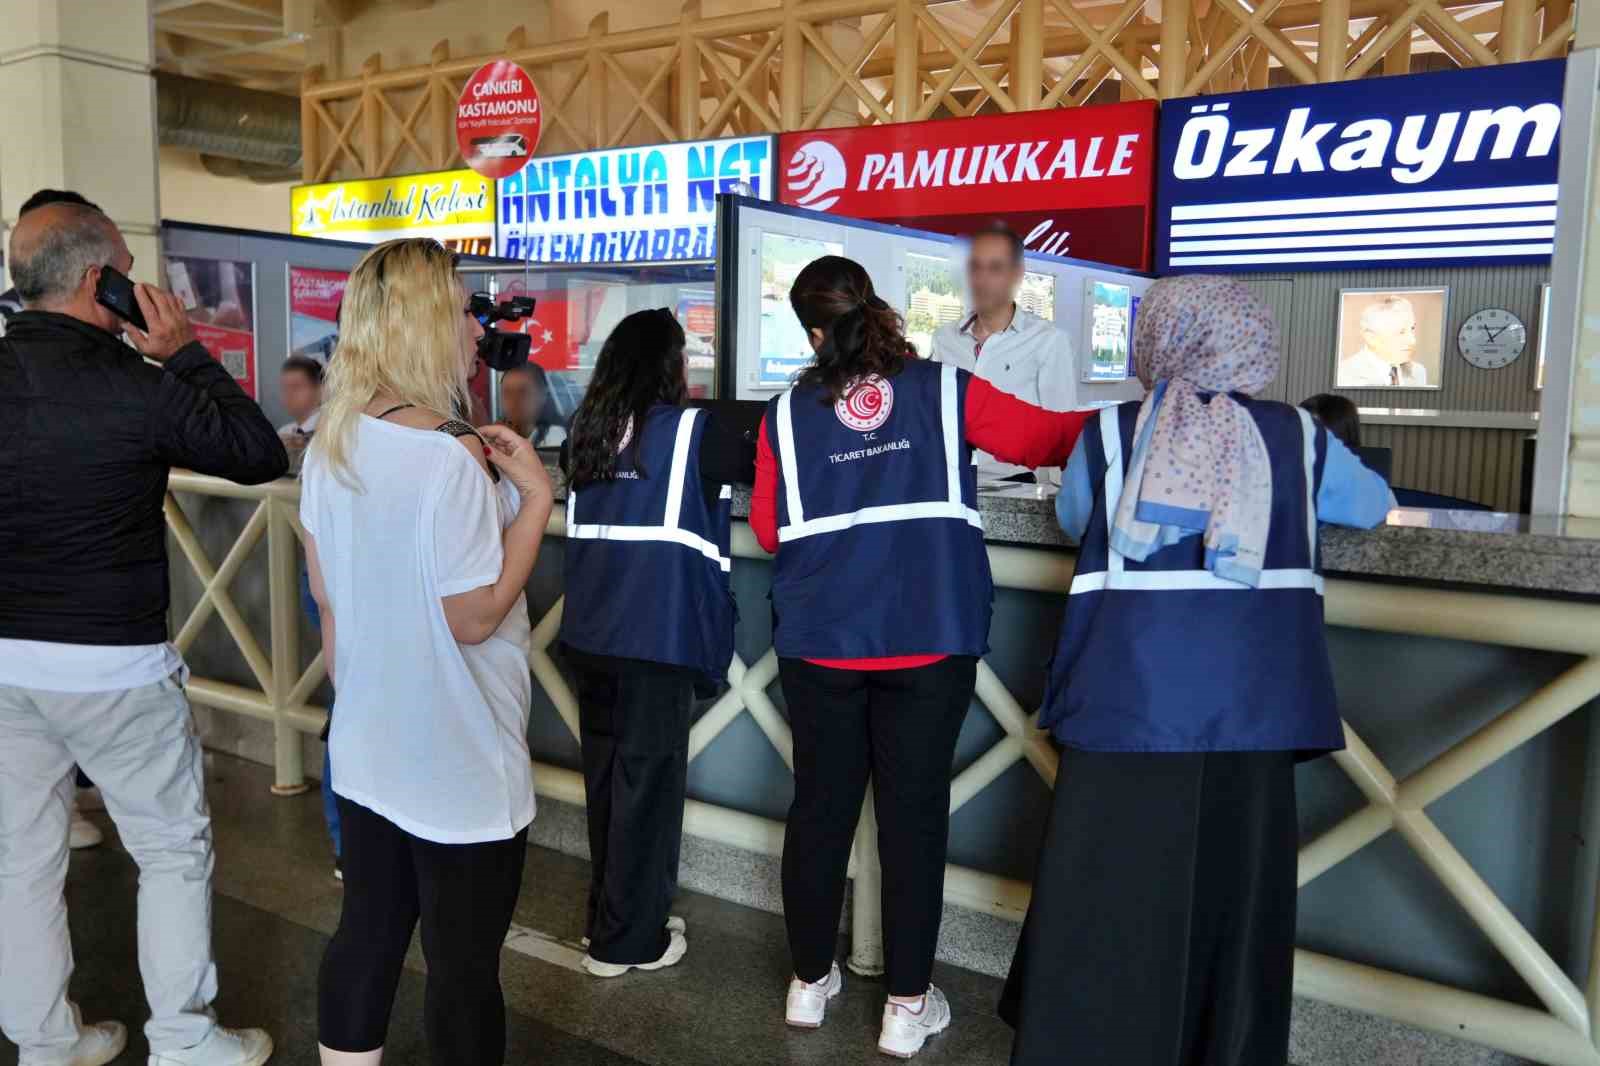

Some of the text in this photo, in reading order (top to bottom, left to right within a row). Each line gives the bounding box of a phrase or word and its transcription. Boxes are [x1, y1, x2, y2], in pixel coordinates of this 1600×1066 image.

[459, 99, 537, 117] KASTAMONU
[473, 80, 522, 100] ÇANKIRI
[857, 134, 1139, 191] PAMUKKALE
[502, 140, 768, 224] ANTALYA NET
[416, 182, 487, 221] Kalesi
[589, 225, 717, 263] DİYARBA
[828, 438, 911, 464] TİCARET BAKANLIĞI
